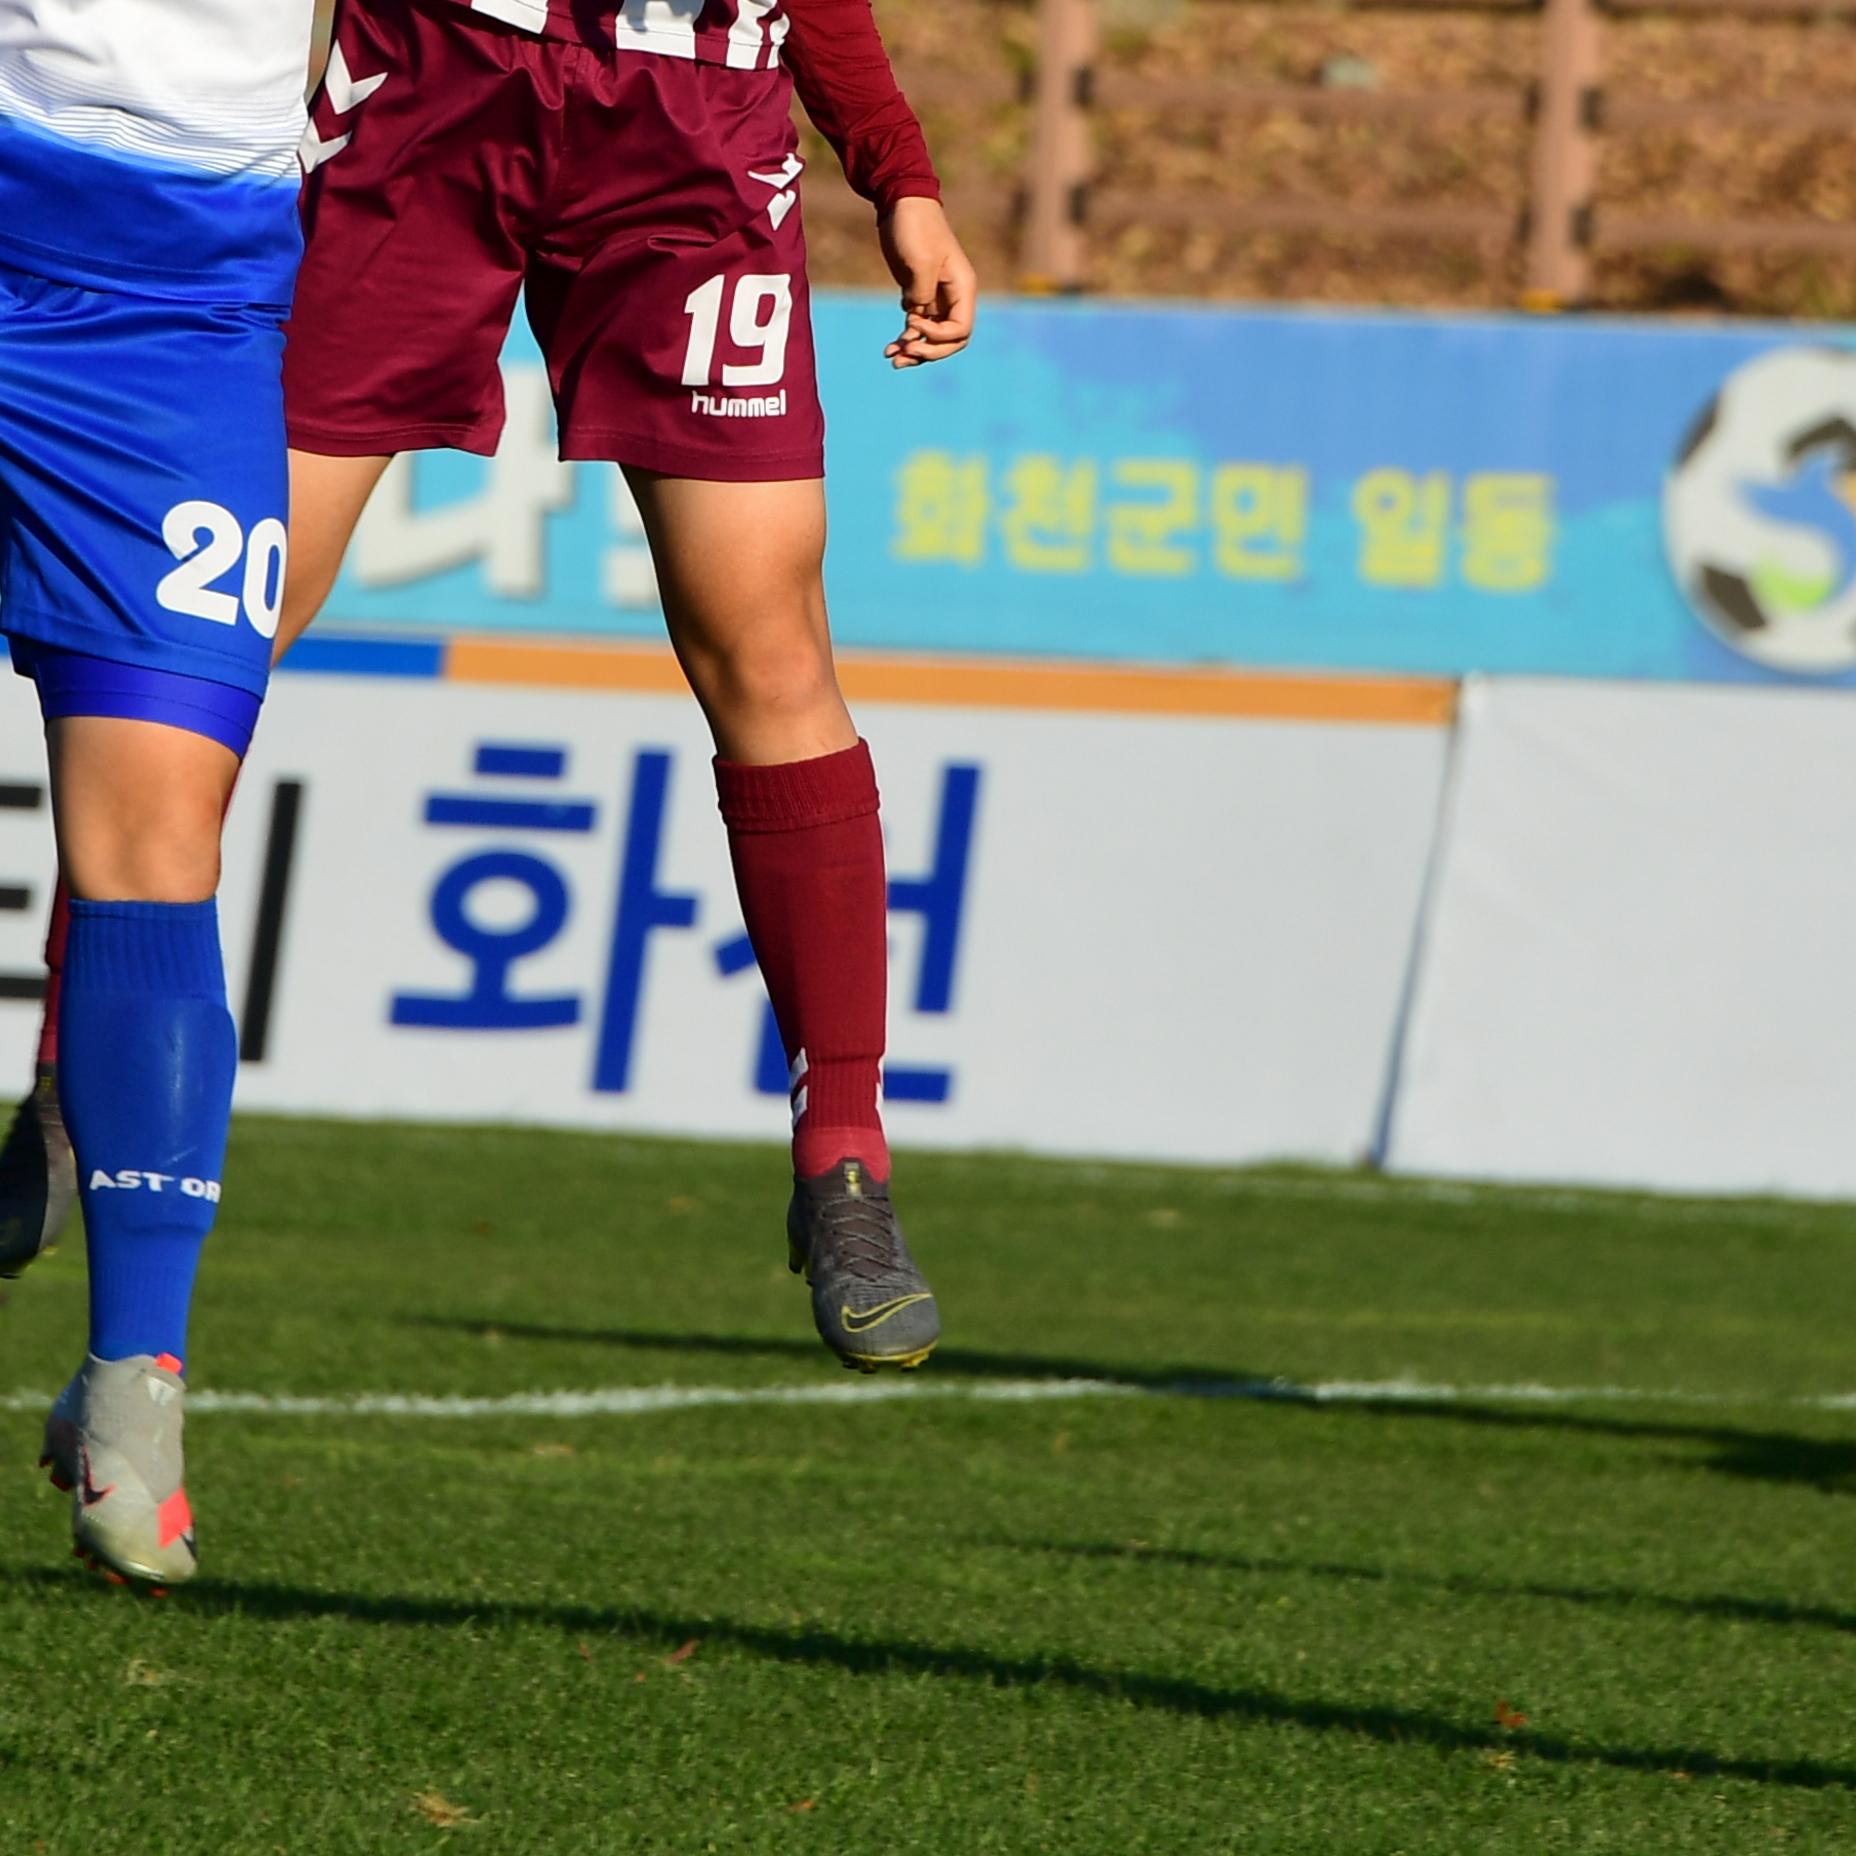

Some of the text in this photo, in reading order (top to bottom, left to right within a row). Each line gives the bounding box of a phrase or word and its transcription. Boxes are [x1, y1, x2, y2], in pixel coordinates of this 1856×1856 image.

[681, 274, 793, 386] 19
[691, 388, 787, 417] hummel
[156, 500, 288, 639] 20
